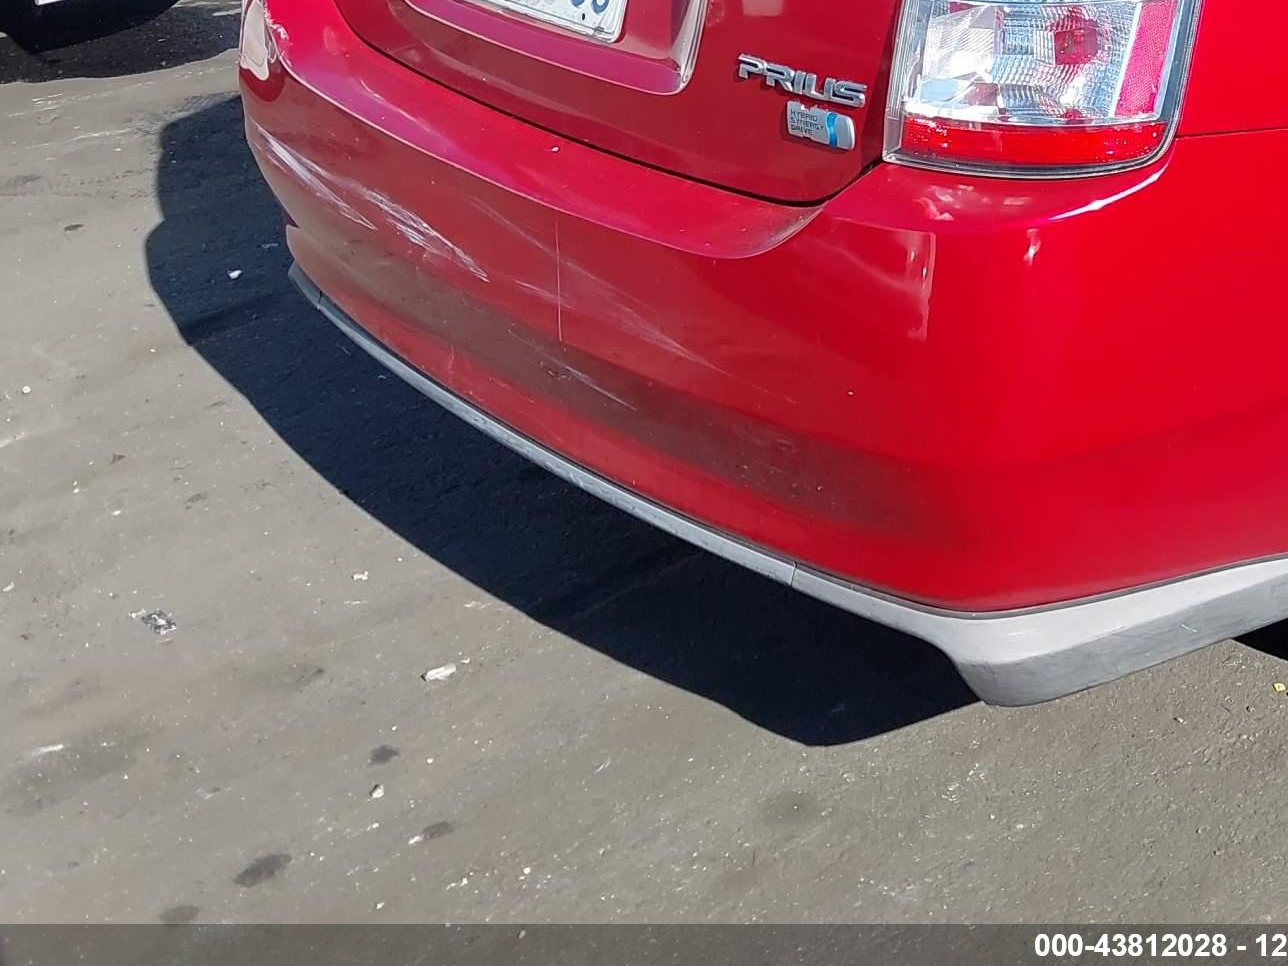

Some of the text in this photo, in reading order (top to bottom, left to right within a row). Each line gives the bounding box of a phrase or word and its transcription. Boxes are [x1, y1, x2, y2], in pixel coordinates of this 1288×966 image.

[738, 53, 867, 107] PRIUS
[790, 109, 818, 122] HYBRID
[790, 116, 825, 131] SYNERGY
[790, 124, 813, 136] DRIVE
